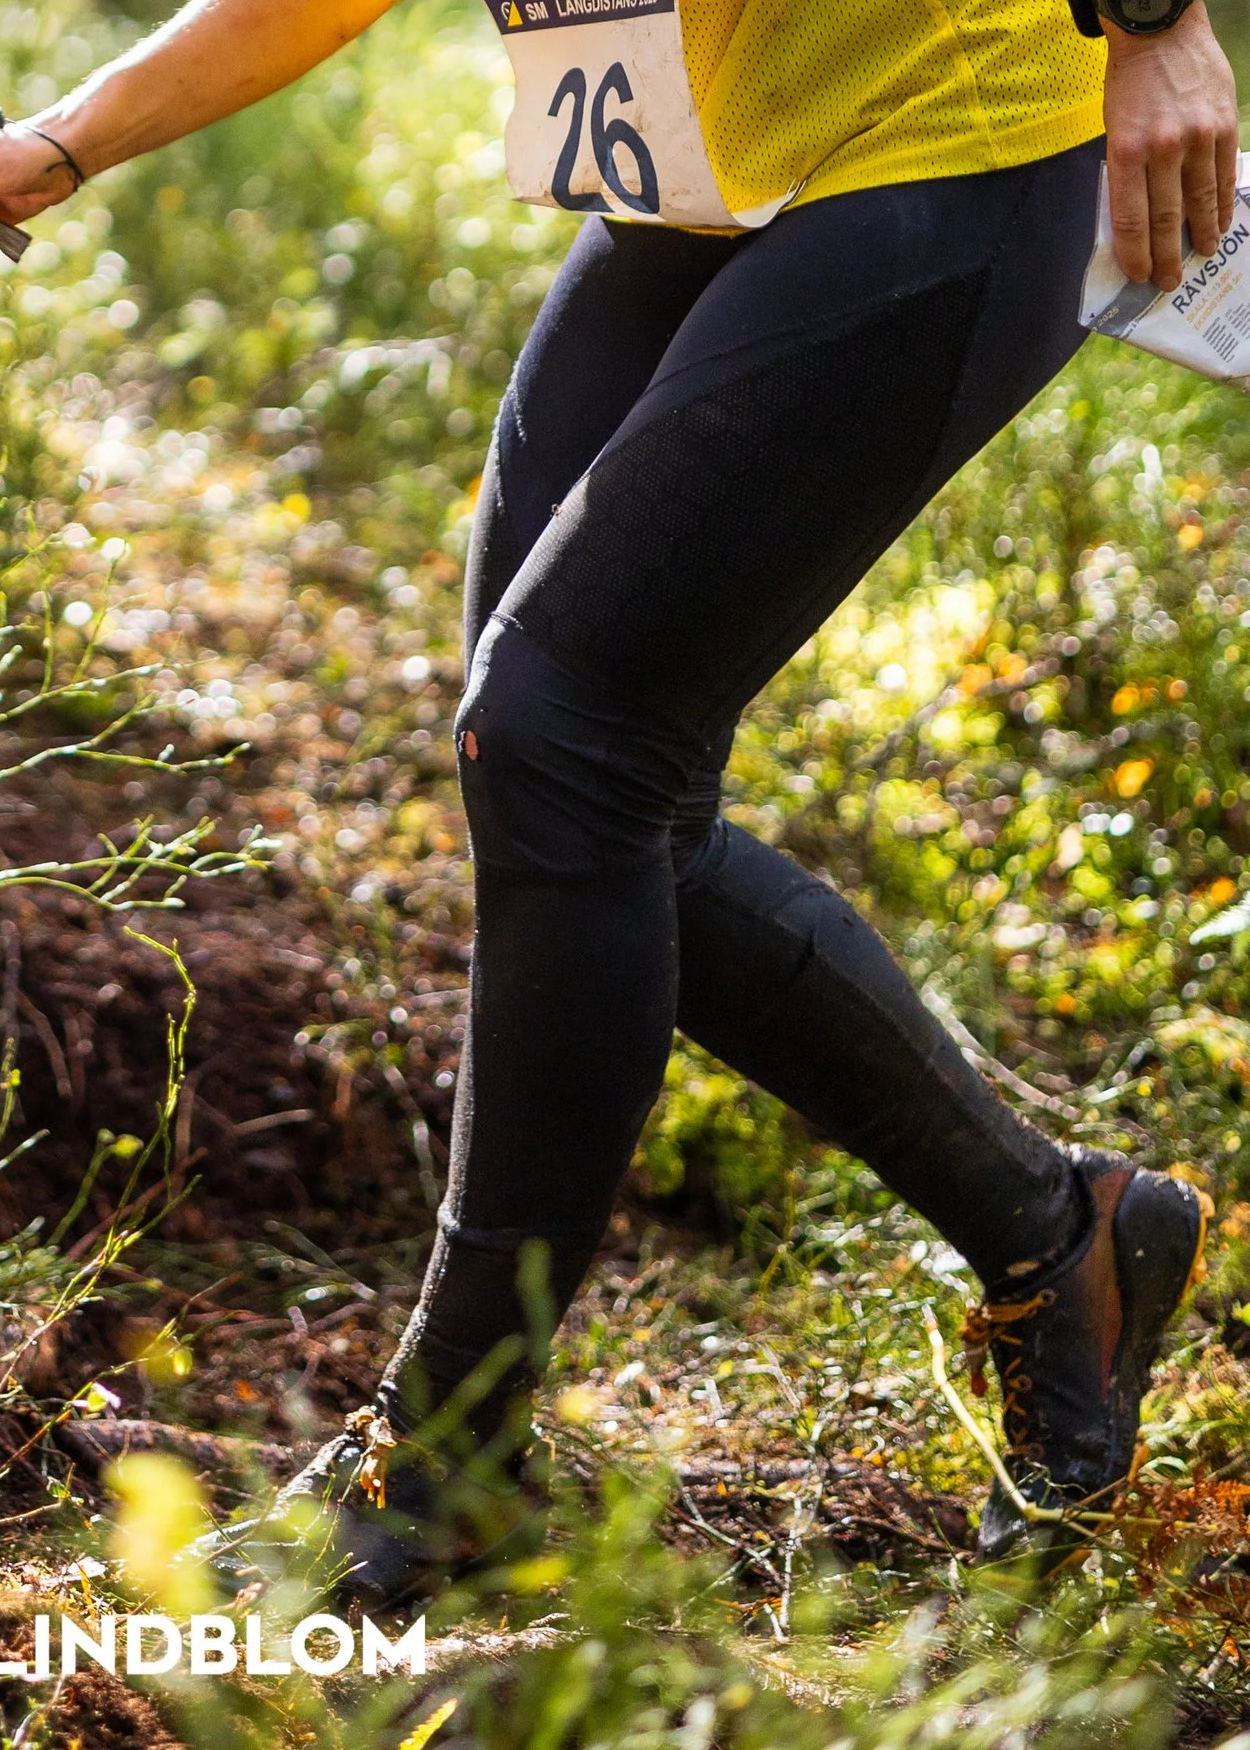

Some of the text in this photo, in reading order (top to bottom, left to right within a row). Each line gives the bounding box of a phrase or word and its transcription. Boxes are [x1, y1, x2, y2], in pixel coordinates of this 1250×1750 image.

[525, 1, 549, 21] SM
[547, 61, 660, 214] 26
[1171, 222, 1250, 315] RÄVSJÖN
